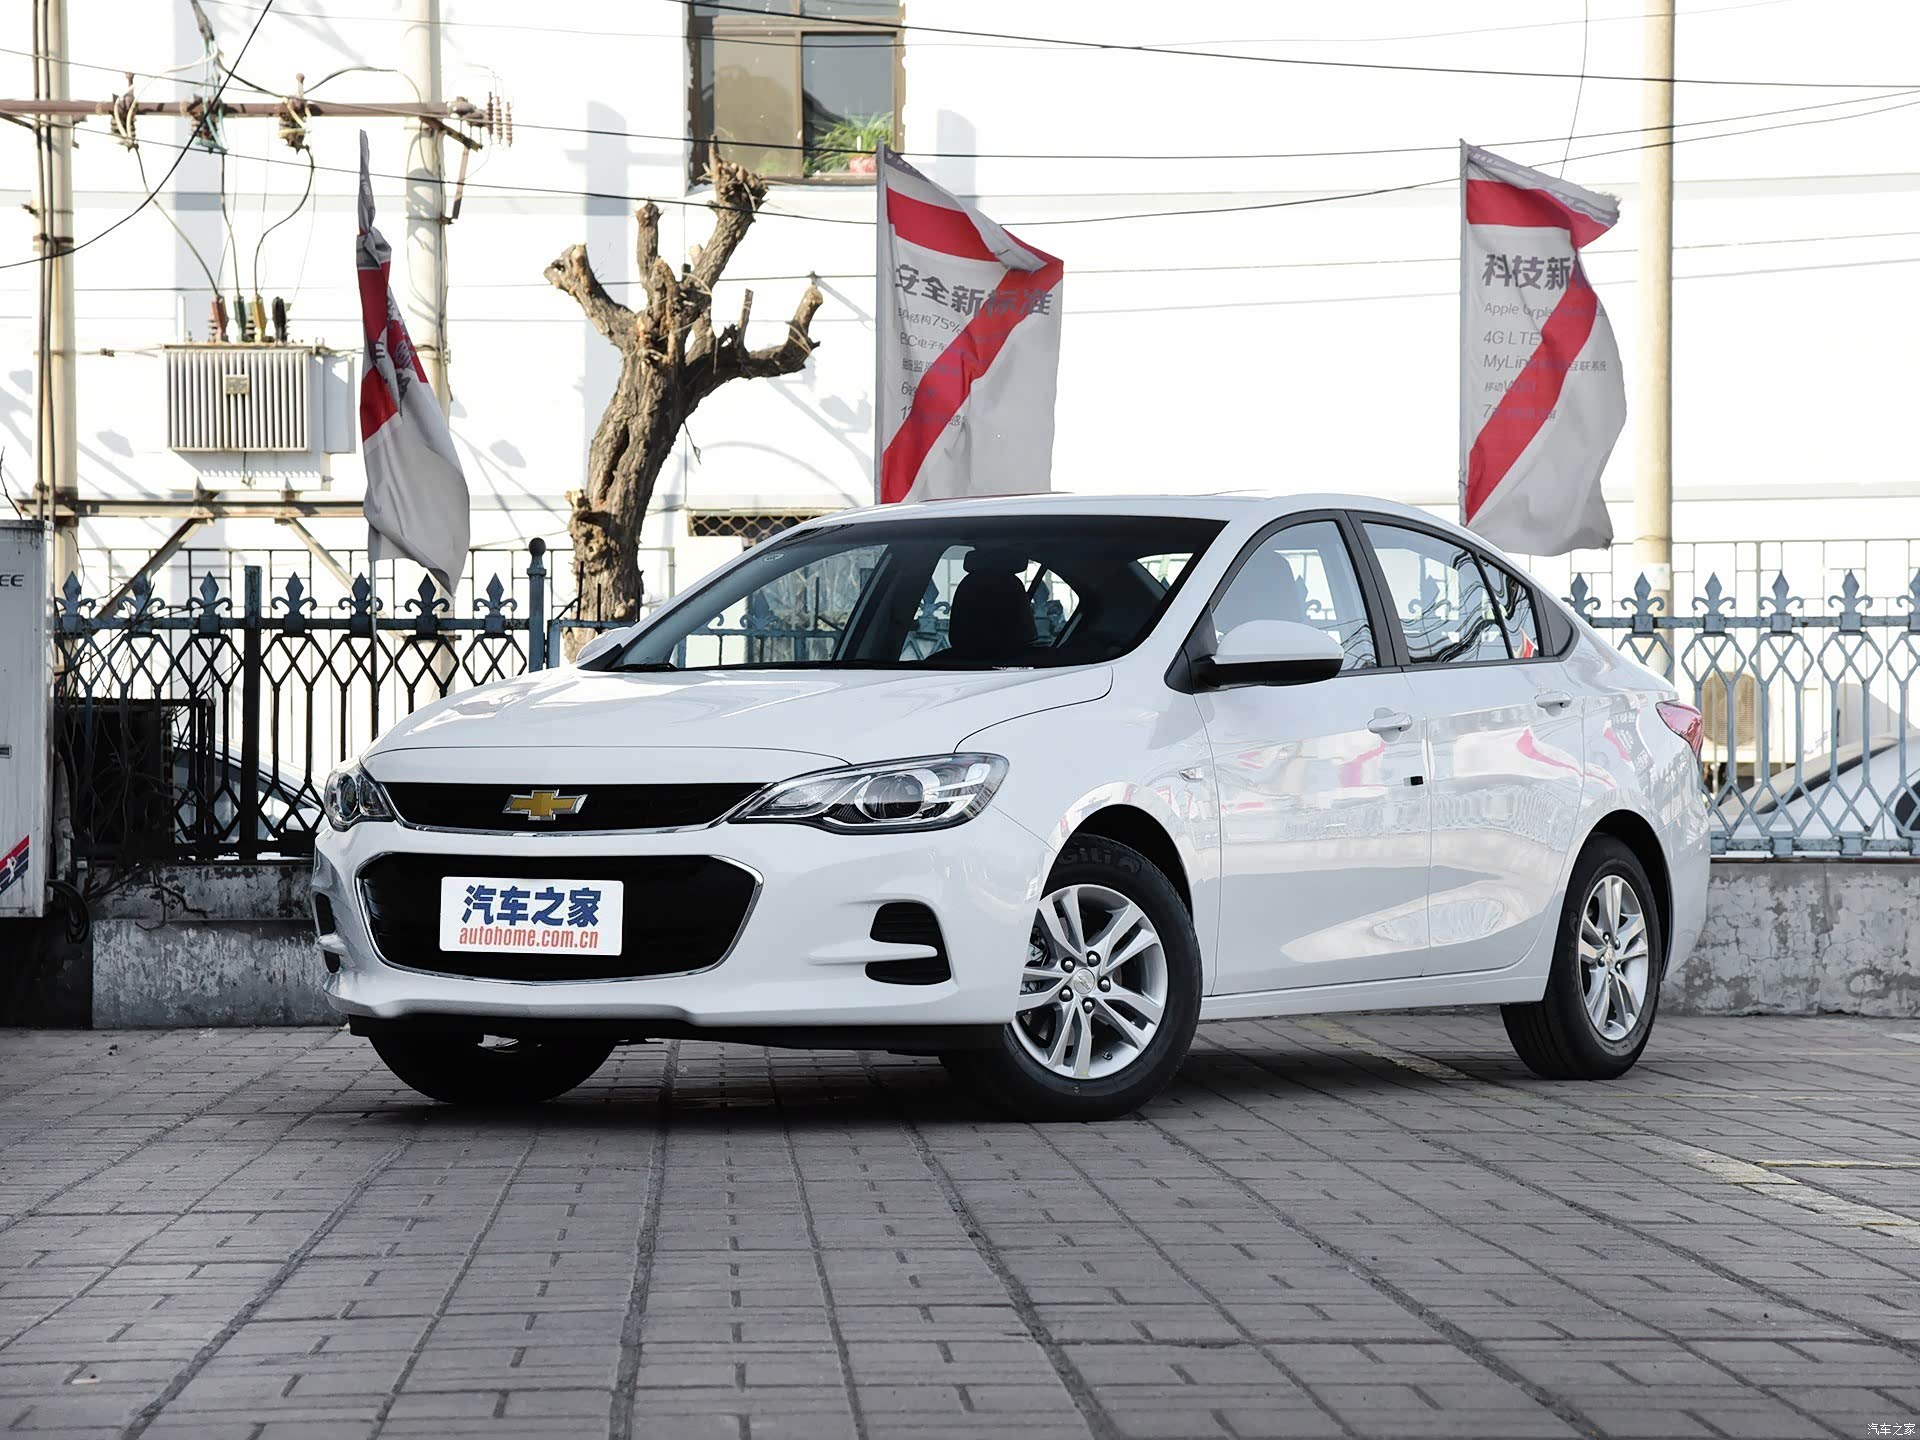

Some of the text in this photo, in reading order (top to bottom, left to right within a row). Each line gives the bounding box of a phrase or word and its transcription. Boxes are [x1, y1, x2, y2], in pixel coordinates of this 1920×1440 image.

[895, 263, 1053, 318] 安全新标准
[1484, 302, 1520, 317] Apple
[1483, 330, 1541, 346] 4G LTE
[461, 885, 602, 928] 汽车之家
[459, 926, 599, 949] autohome.com.cn
